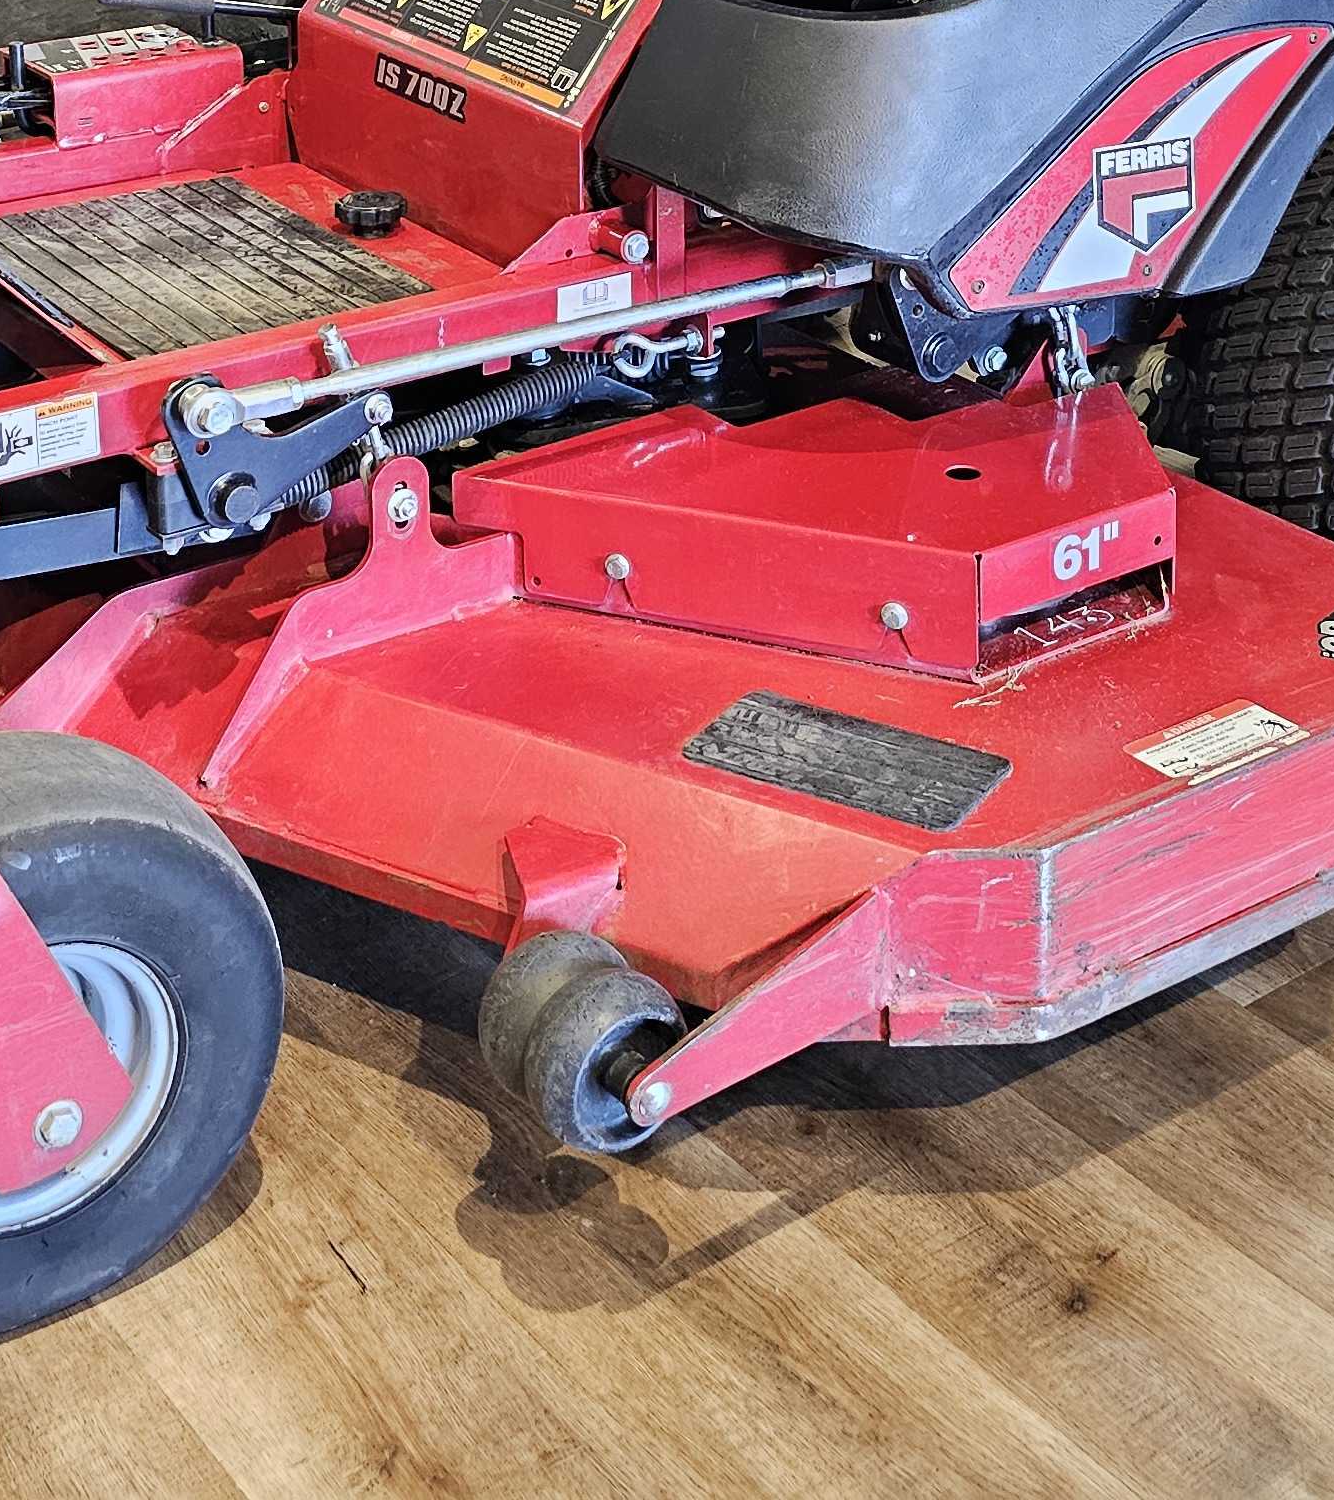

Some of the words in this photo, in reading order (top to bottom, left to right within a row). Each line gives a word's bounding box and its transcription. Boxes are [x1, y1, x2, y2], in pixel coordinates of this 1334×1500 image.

[376, 57, 401, 90] IS
[403, 64, 466, 119] 700Z
[1100, 140, 1190, 177] FERRIS
[48, 398, 93, 416] WARNING
[1053, 520, 1119, 581] 61"
[1170, 713, 1216, 735] DANGER
